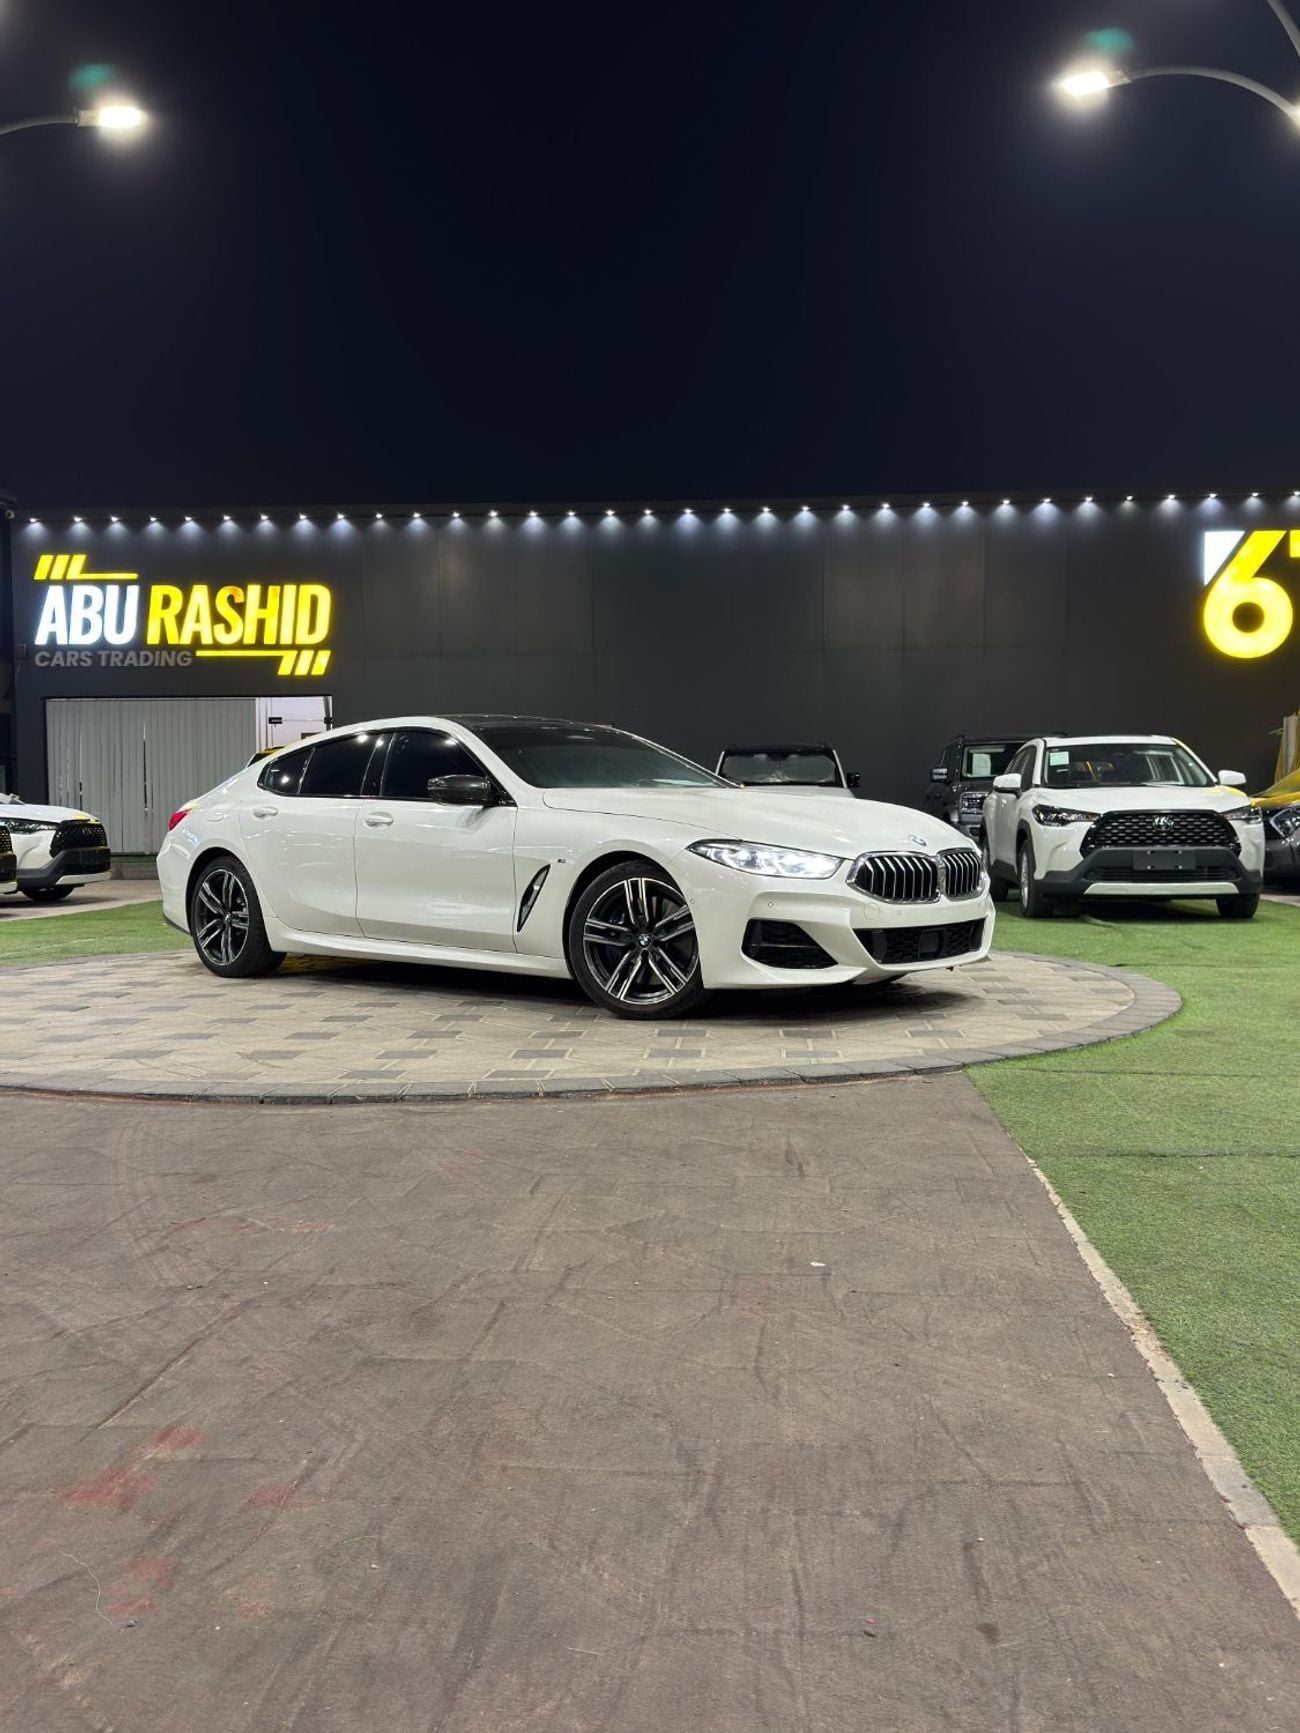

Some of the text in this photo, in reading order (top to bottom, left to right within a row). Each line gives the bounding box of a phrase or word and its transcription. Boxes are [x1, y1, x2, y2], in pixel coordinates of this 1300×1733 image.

[34, 584, 331, 645] ABU RASHID
[1203, 530, 1300, 659] 6
[34, 650, 193, 667] CARS TRADING
